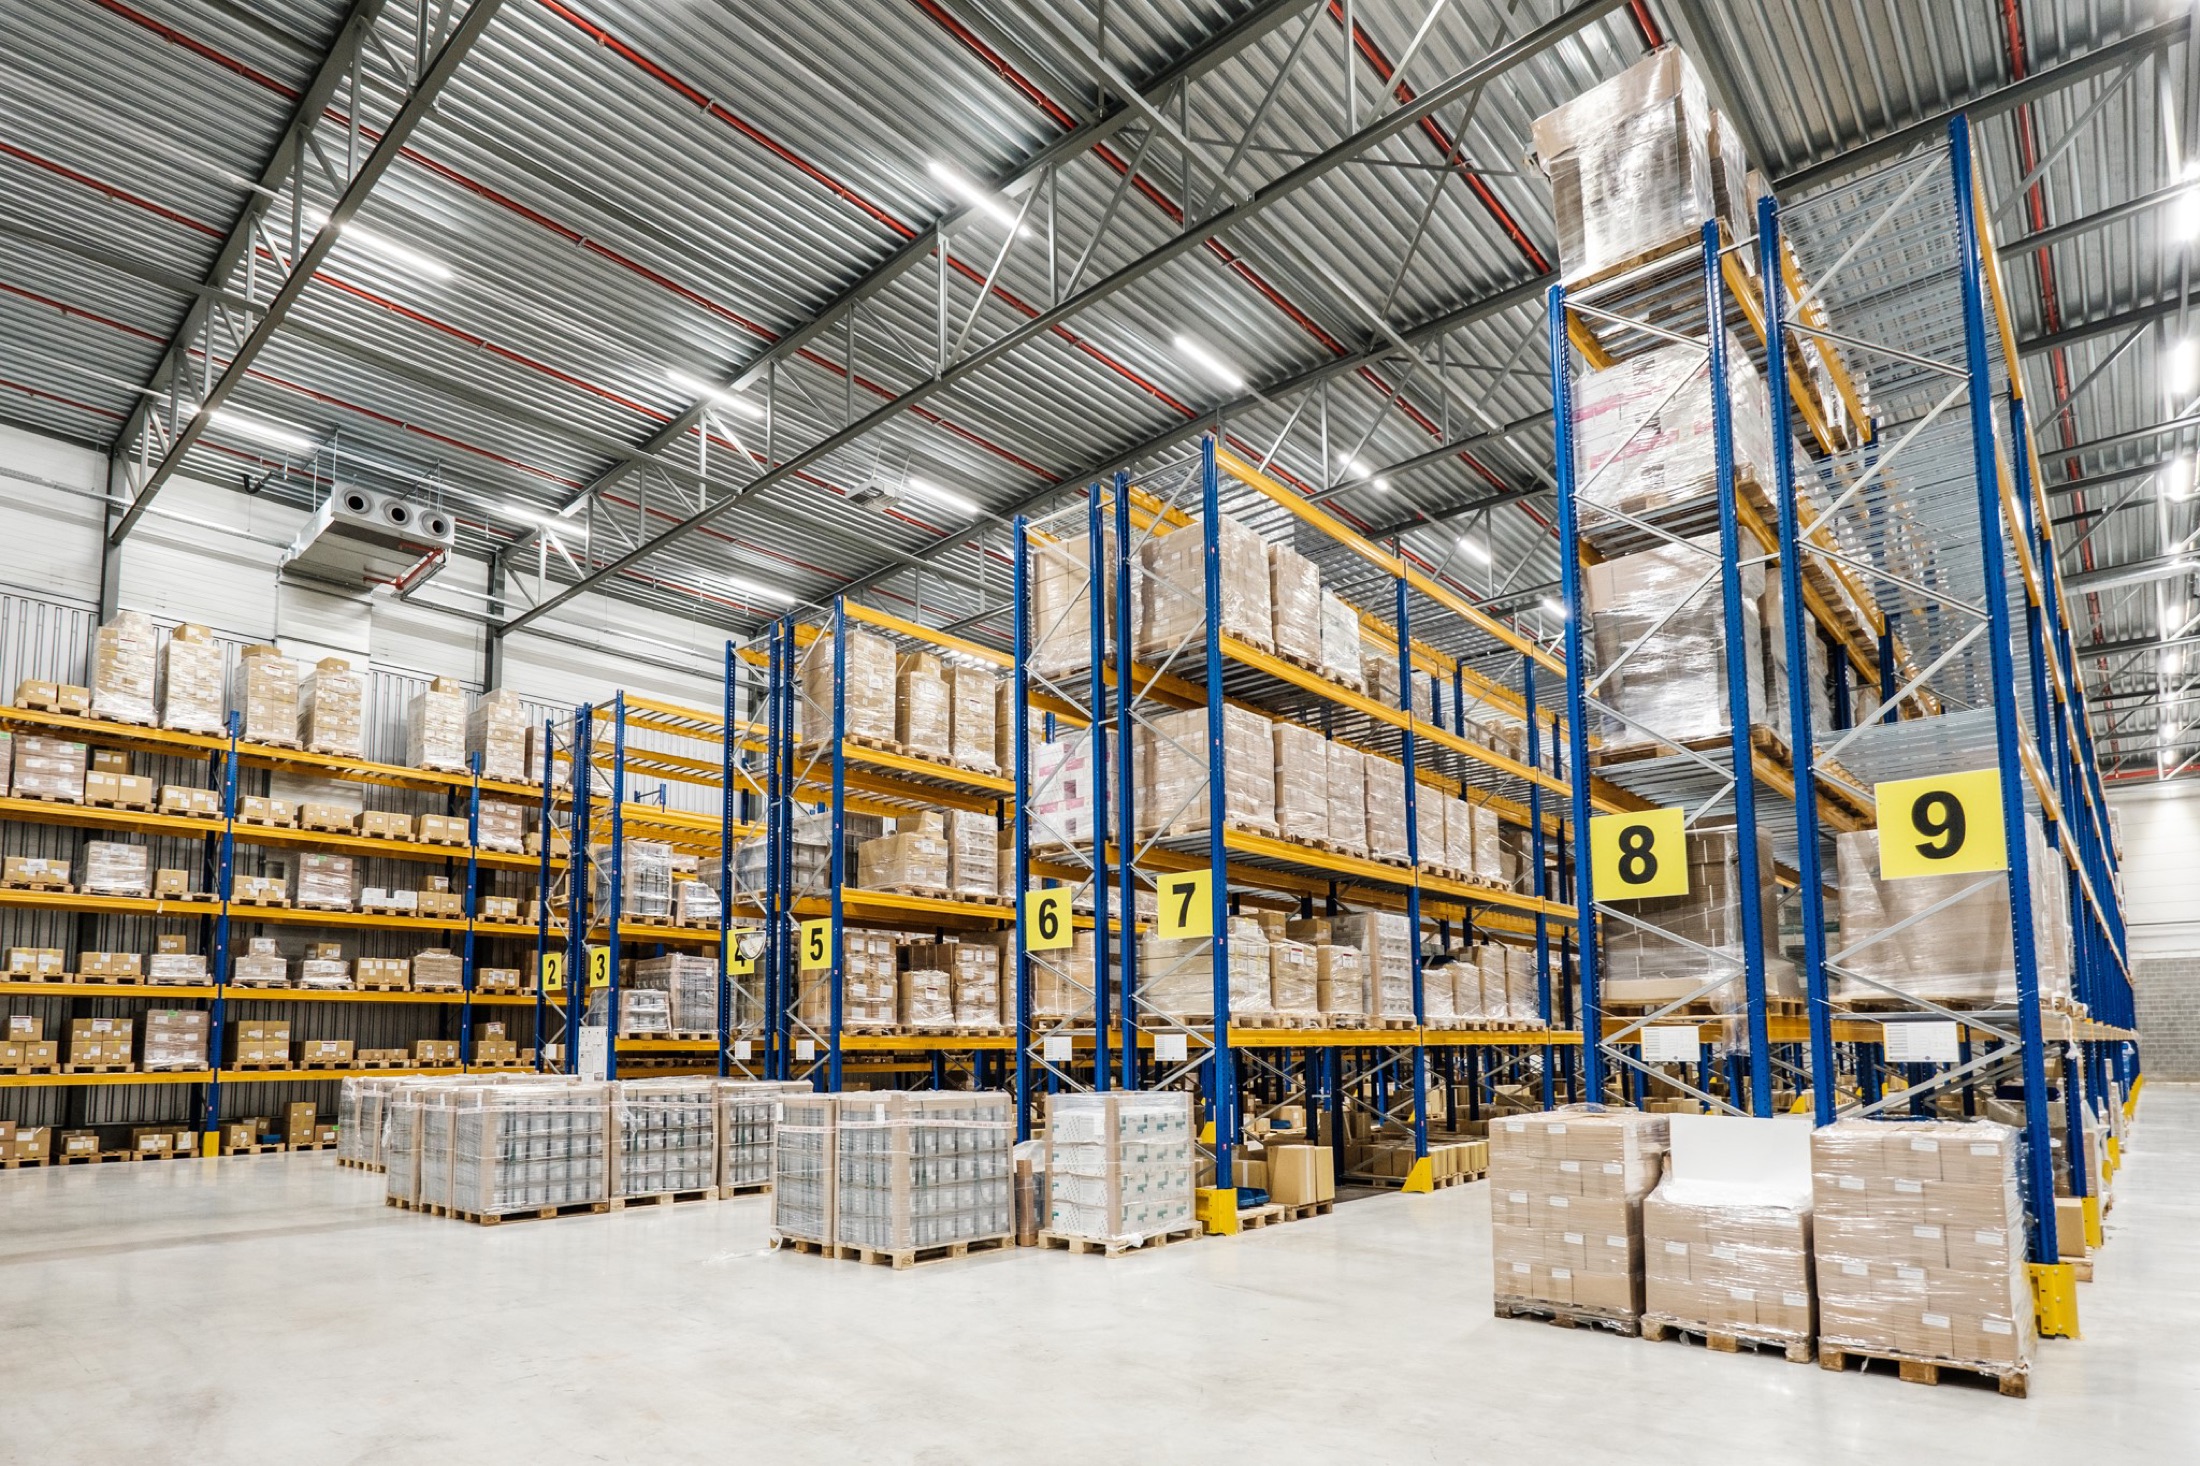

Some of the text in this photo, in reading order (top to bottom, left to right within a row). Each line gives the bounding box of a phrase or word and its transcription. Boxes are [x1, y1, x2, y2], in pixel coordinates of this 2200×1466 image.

[1912, 790, 1965, 860] 9
[1618, 825, 1658, 885] 8
[1038, 898, 1058, 939] 6
[1173, 883, 1196, 928] 7
[809, 928, 824, 961] 5
[547, 959, 556, 985] 2
[595, 953, 605, 981] 3
